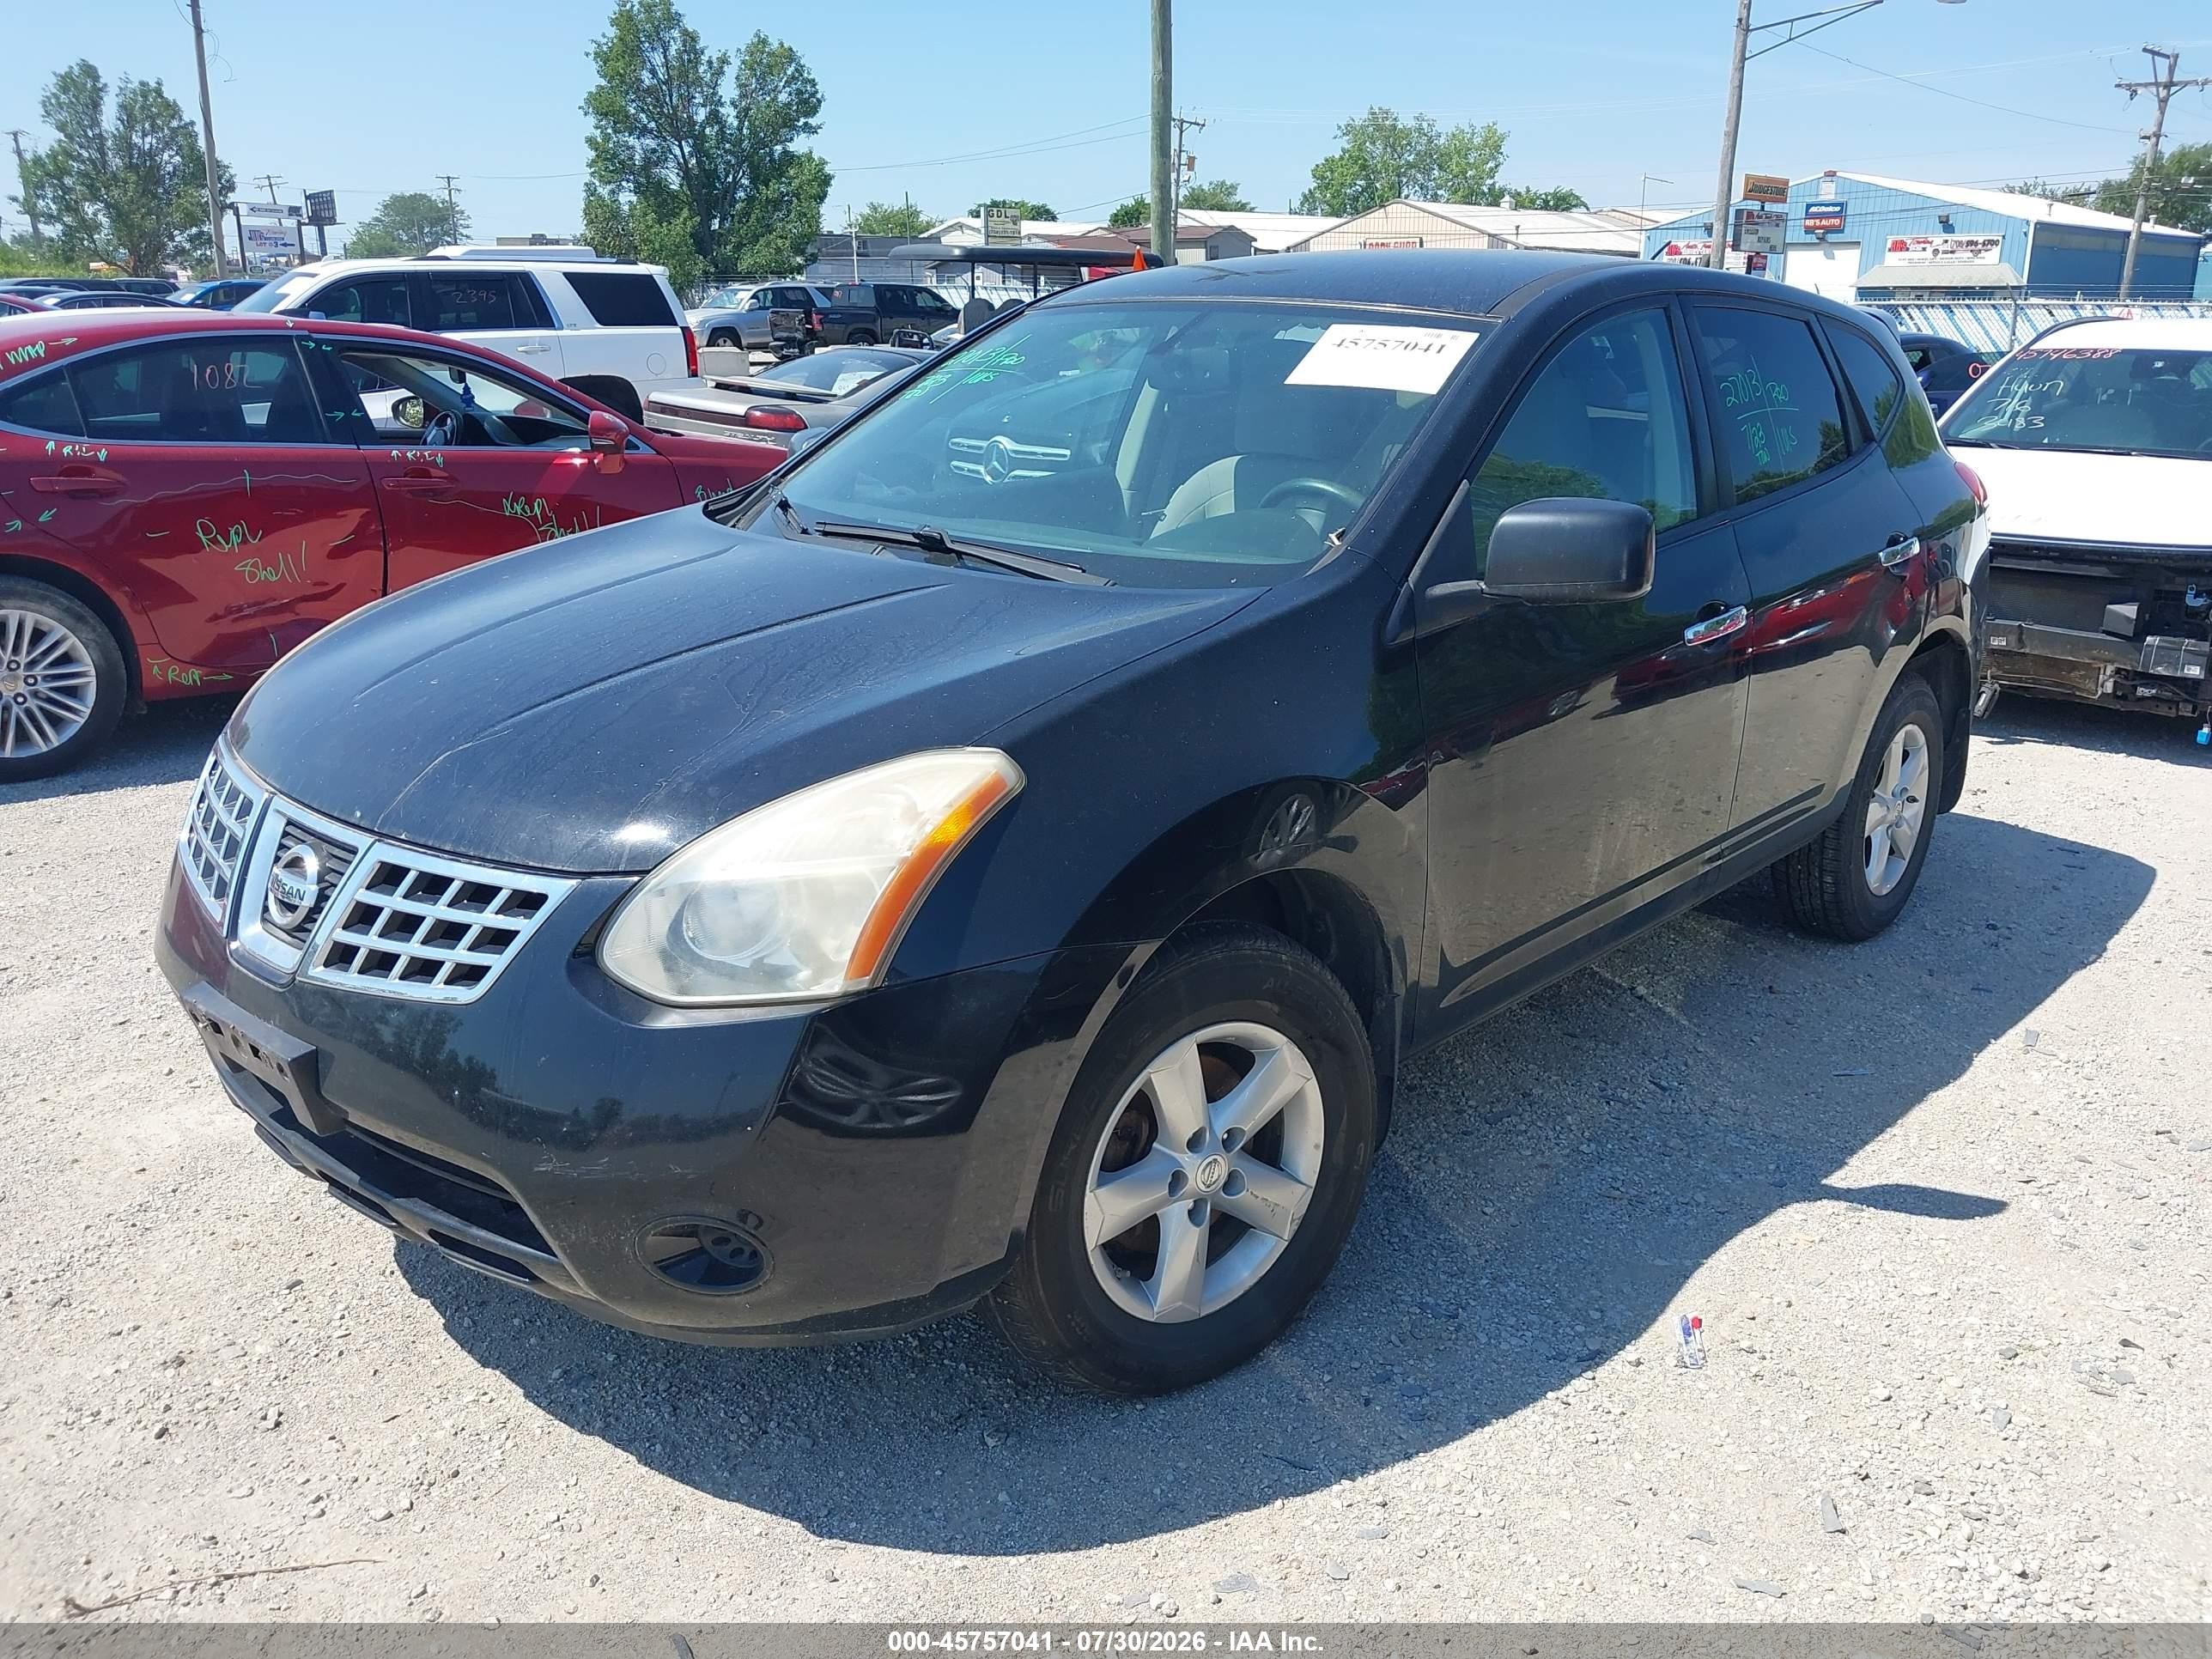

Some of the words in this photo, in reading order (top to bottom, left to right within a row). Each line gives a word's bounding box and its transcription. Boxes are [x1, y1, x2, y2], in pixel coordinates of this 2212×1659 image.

[1747, 183, 1787, 197] BRIDGESTONE
[1820, 218, 1841, 227] AUTO
[1332, 337, 1447, 355] 45757041
[270, 875, 307, 902] NISSAN
